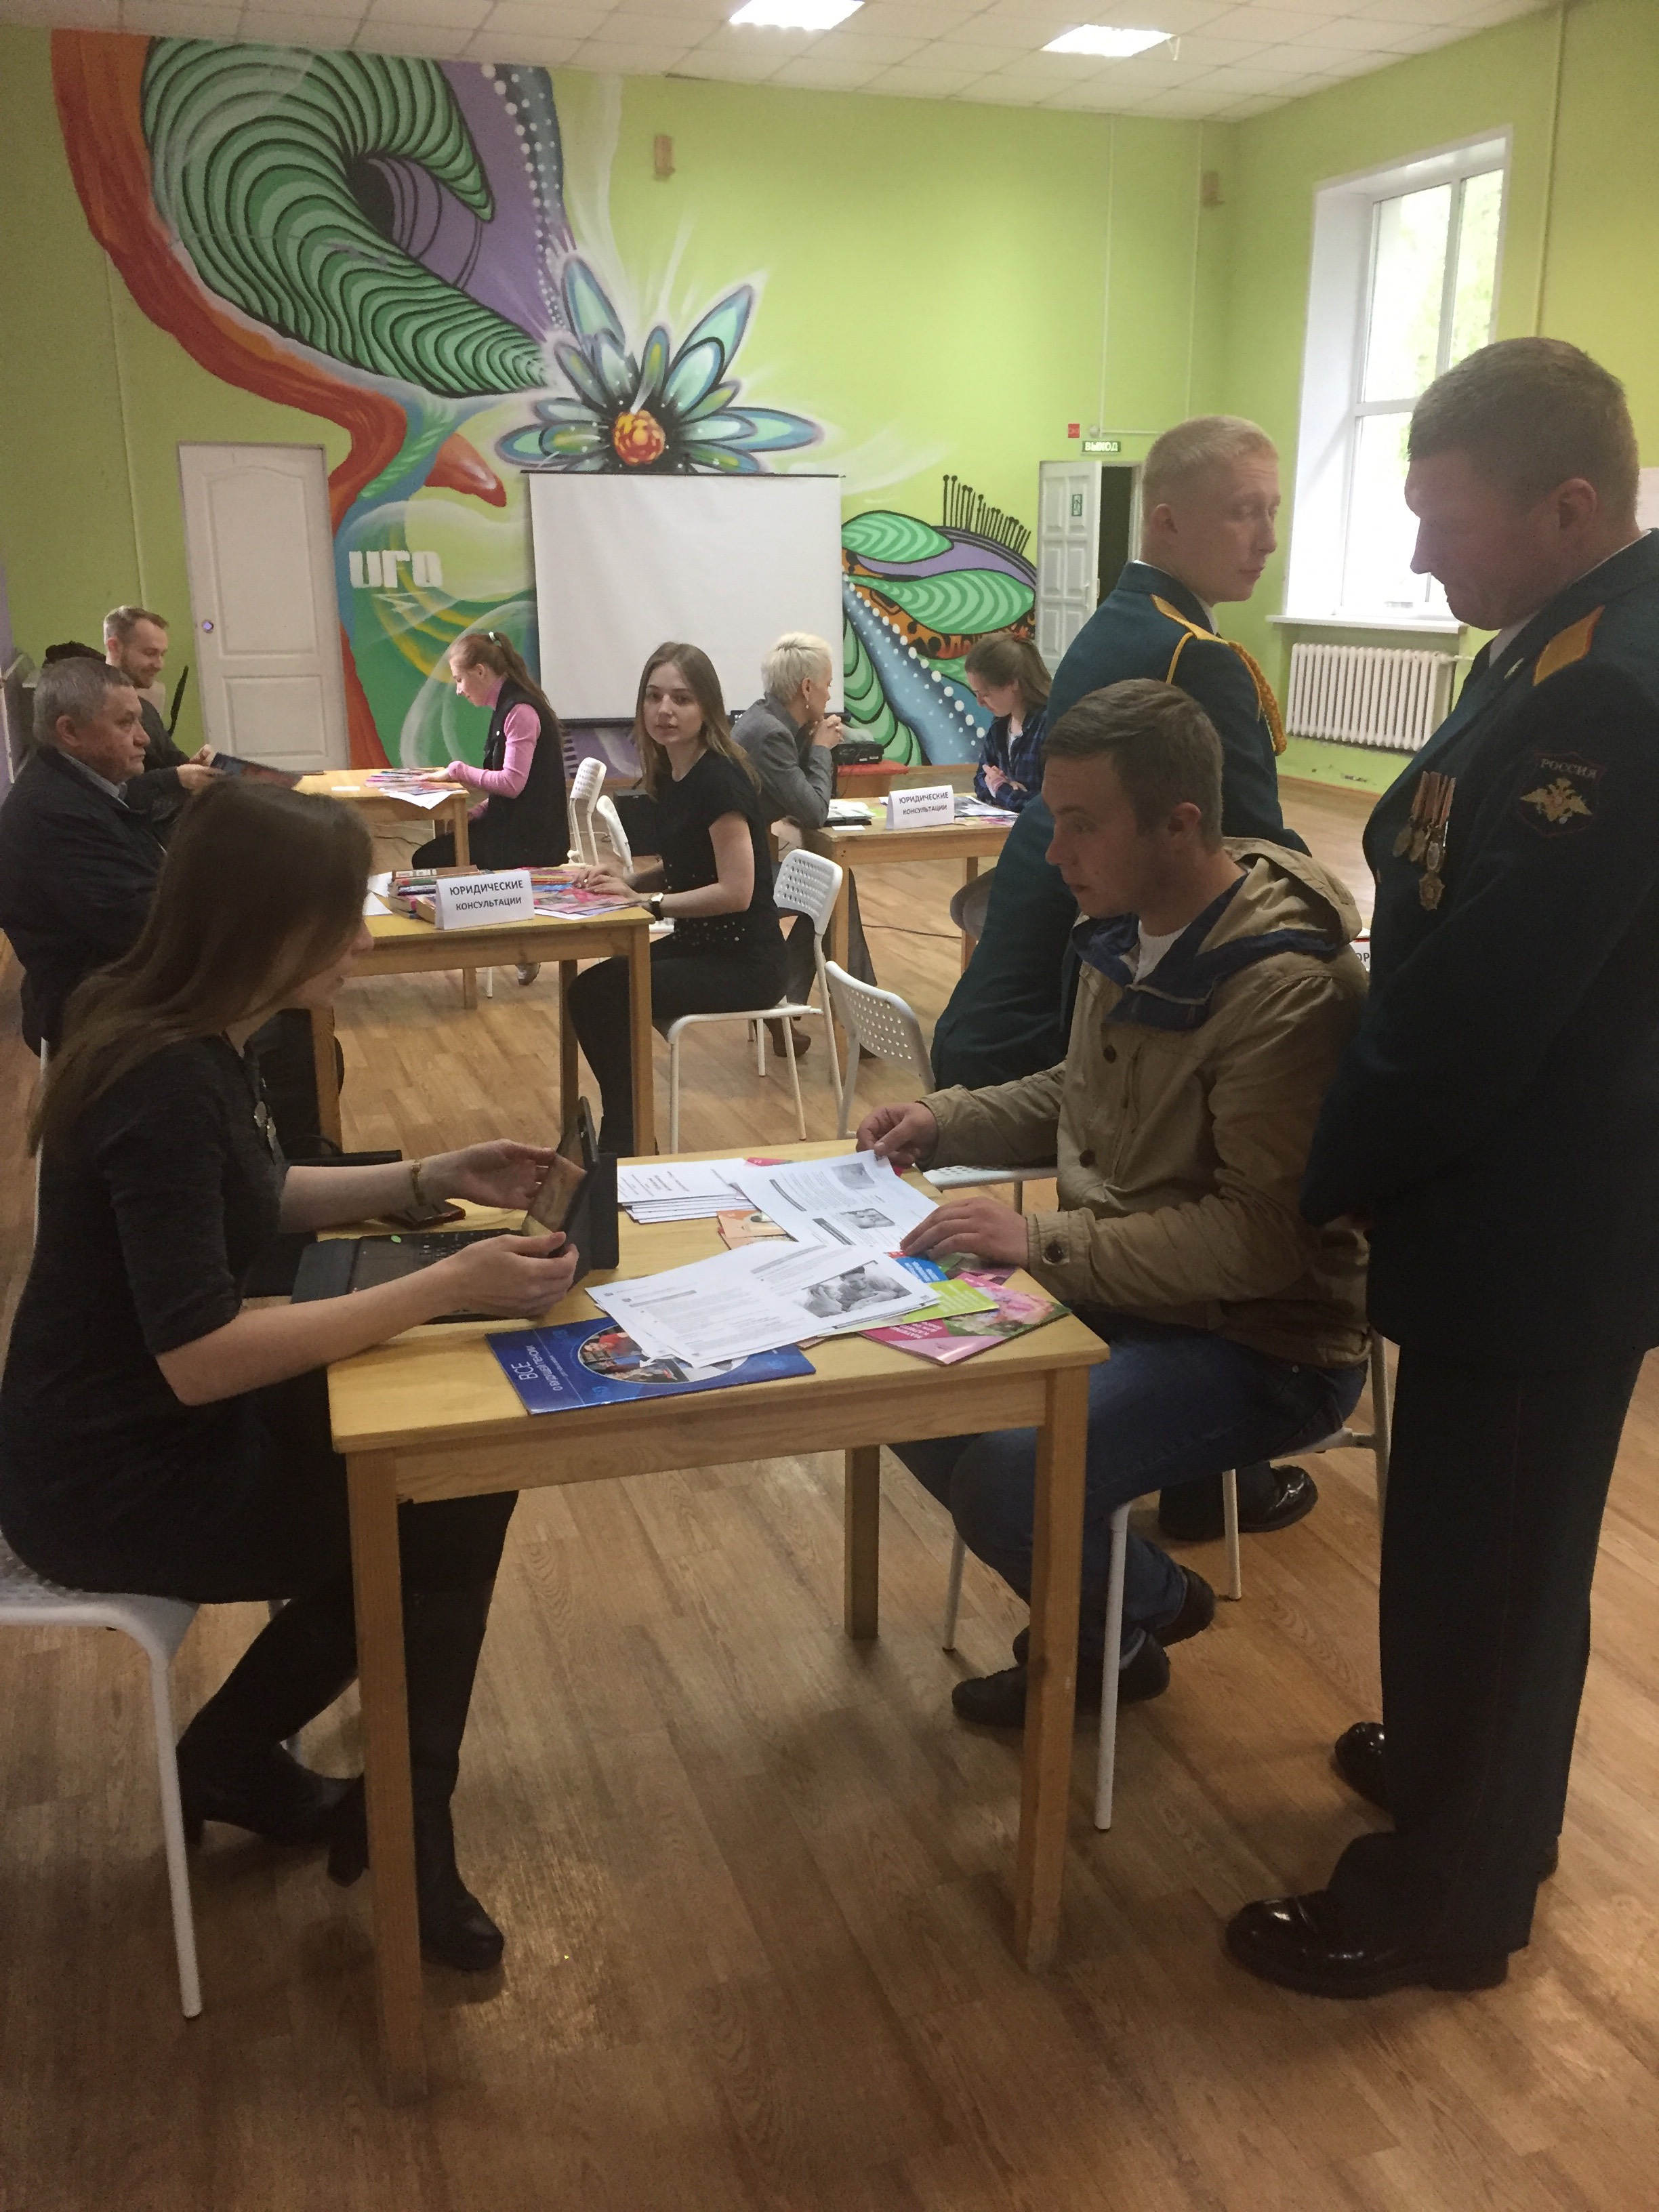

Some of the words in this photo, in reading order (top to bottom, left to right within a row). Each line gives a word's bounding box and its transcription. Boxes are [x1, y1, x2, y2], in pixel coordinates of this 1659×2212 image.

[1085, 441, 1118, 452] ВЫХОД
[1540, 758, 1597, 779] РОССИЯ
[899, 792, 949, 804] ЮРИДИЧЕСКИЕ
[903, 804, 947, 815] КОНСУЛЬТАЦИИ
[449, 880, 524, 895] ЮРИДИЧЕСКИЕ
[456, 897, 522, 910] КОНСУЛЬТАЦИИ
[511, 1361, 539, 1380] ВСЕ
